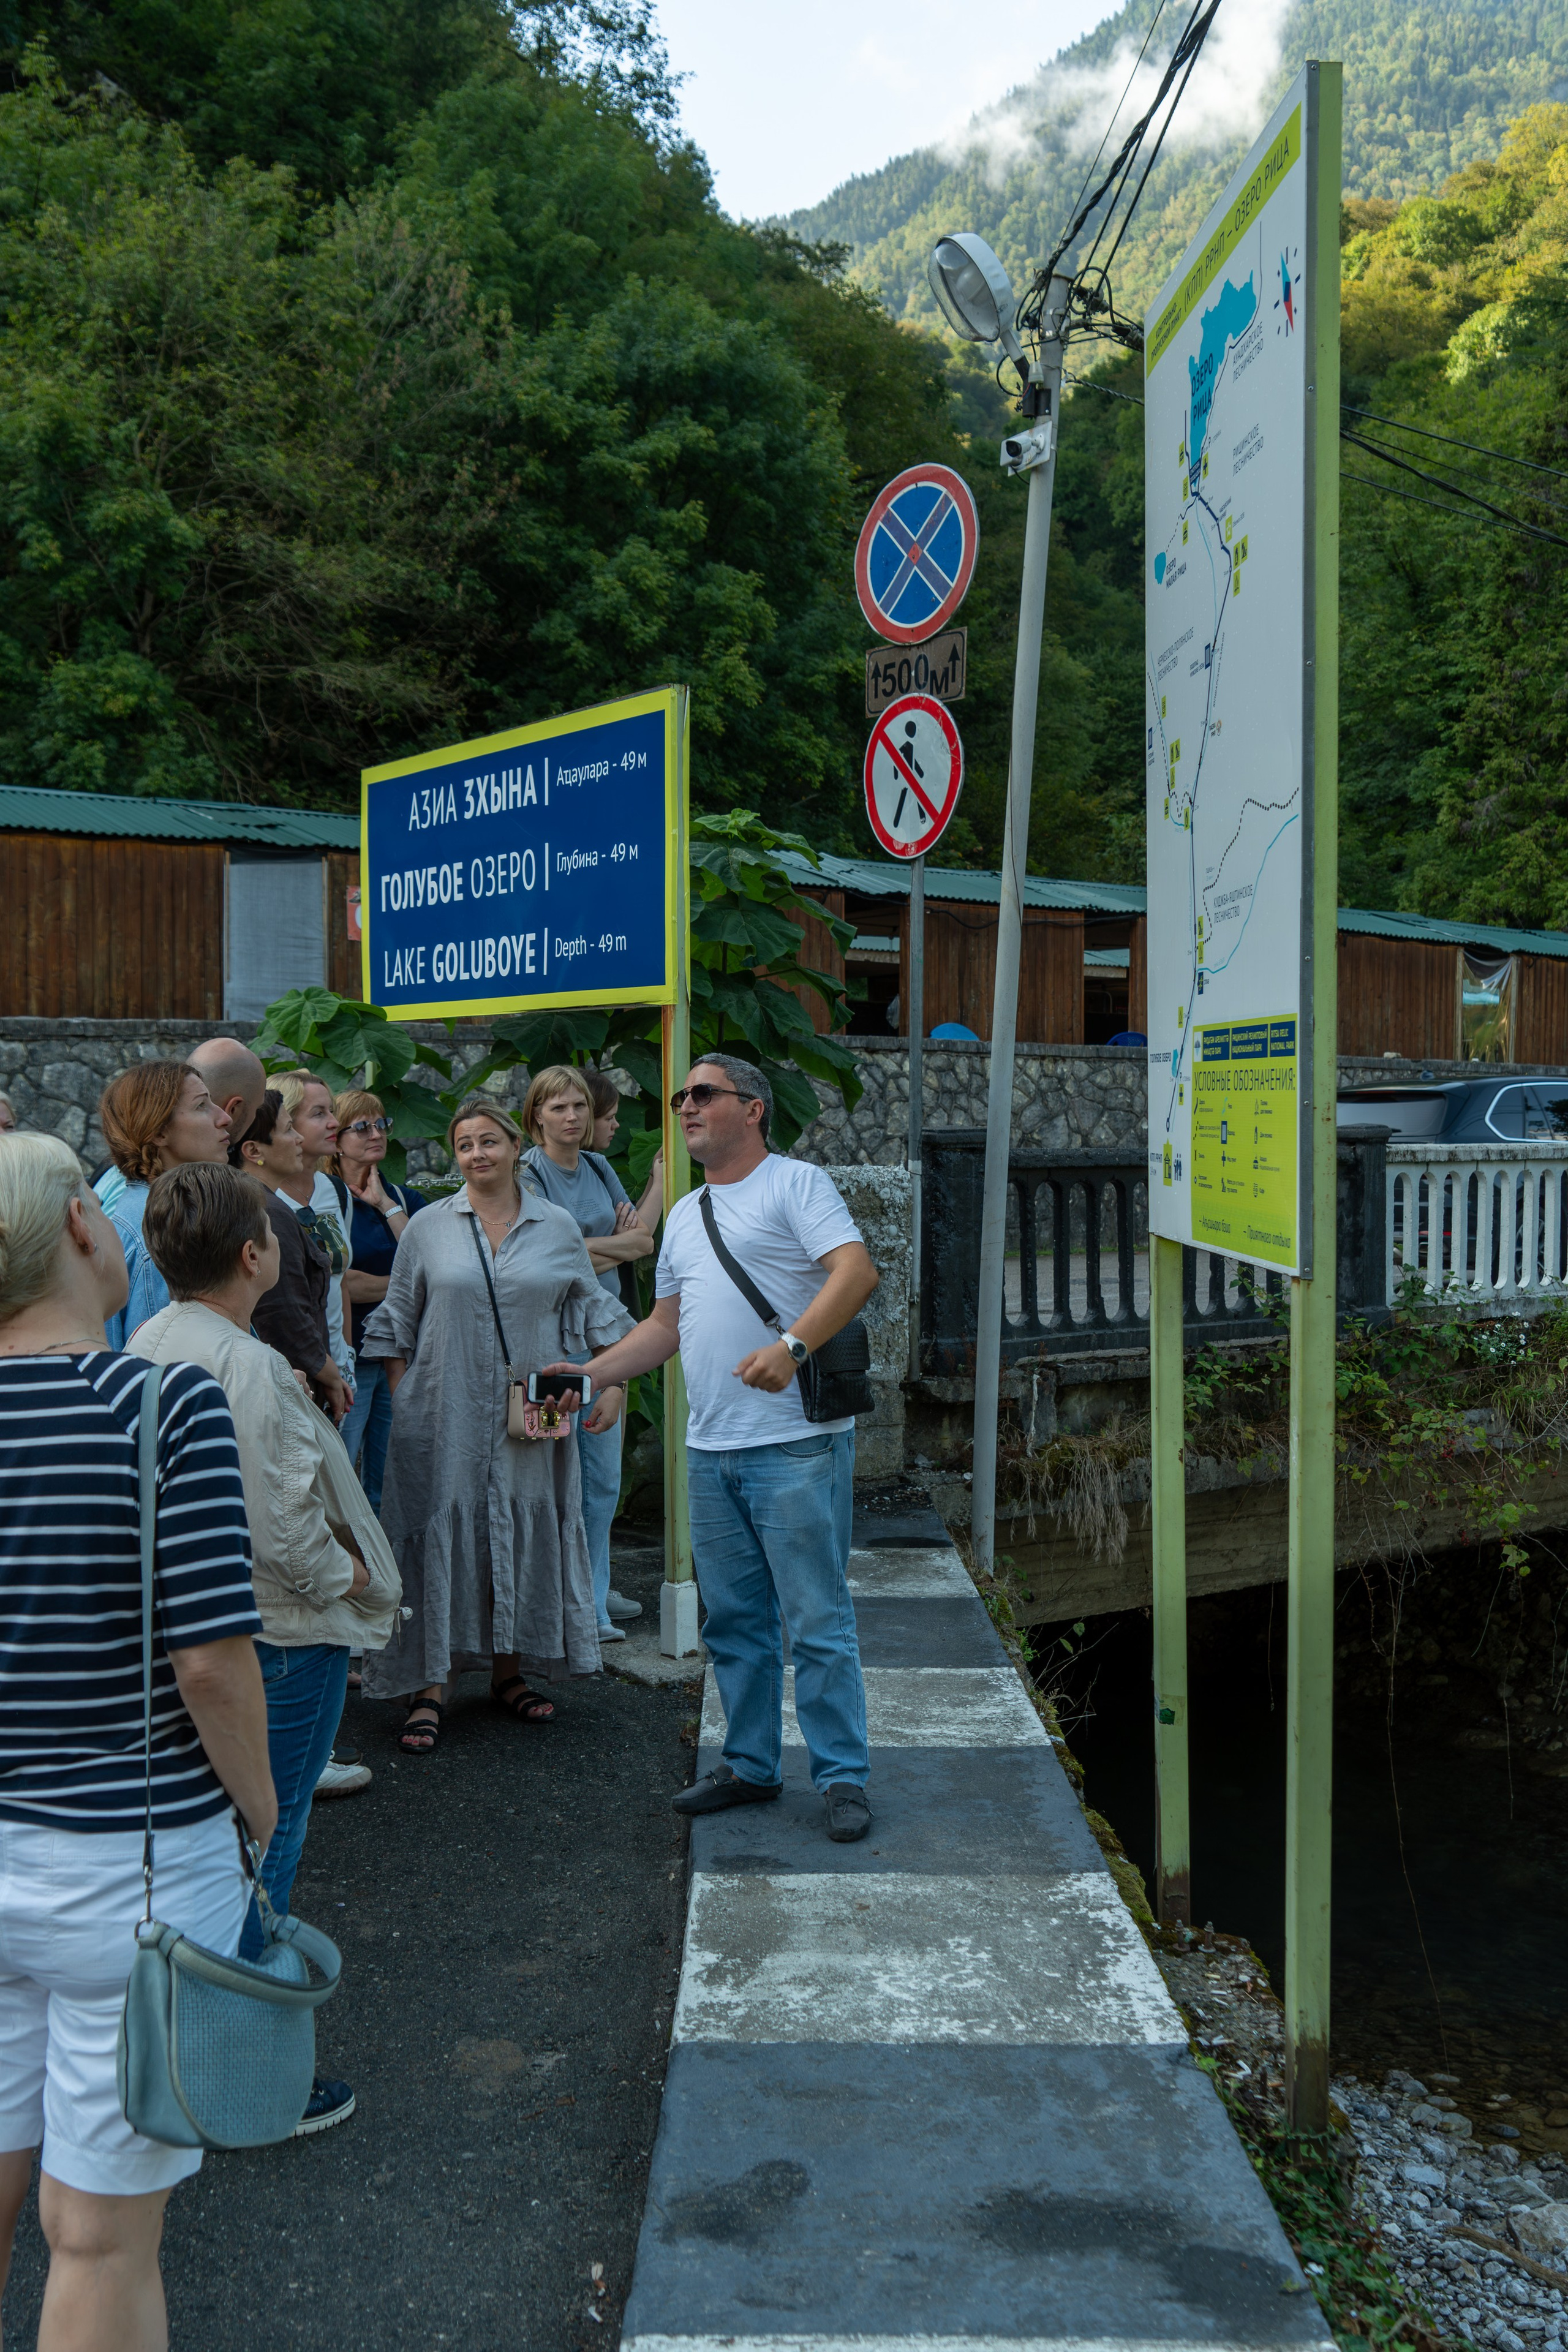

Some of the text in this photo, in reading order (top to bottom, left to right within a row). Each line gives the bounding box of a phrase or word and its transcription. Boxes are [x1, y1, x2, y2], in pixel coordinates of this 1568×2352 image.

[1184, 265, 1203, 312] (КПП)
[1205, 231, 1224, 277] РРНП
[1235, 176, 1262, 232] ОЗЕРО
[1264, 135, 1290, 190] РИЦА
[1171, 307, 1182, 331] ПУНКТ
[1191, 353, 1213, 397] ОЗЕРО
[1233, 338, 1264, 383] ЛЕСНИЧЕСТВО
[1193, 389, 1212, 426] РИЦА
[1233, 423, 1259, 460] РИЦИНСКОЕ
[1233, 436, 1264, 477] ЛЕСНИЧЕСТВО
[1166, 557, 1176, 575] ОЗЕРО
[1177, 562, 1187, 579] РИЦА
[557, 848, 598, 876] Глубина
[610, 842, 626, 863] 49
[381, 848, 536, 913] ГОЛУБОЕ ОЗЕРО
[1214, 905, 1240, 924] ЛЕСНИЧЕСТВО
[384, 932, 537, 987] LAKE GOLUBOYE
[555, 935, 587, 961] Depth
[598, 933, 613, 952] 49
[1150, 1052, 1171, 1063] ГОЛУБОЕ ОЗЕРО
[1270, 1041, 1294, 1050] NATIONAL PARK
[1194, 1068, 1295, 1091] УСЛОВНЫЕ ОБОЗНАЧЕНИЯ:
[1247, 1225, 1271, 1243] Приятного
[1272, 1232, 1291, 1249] отдыха
